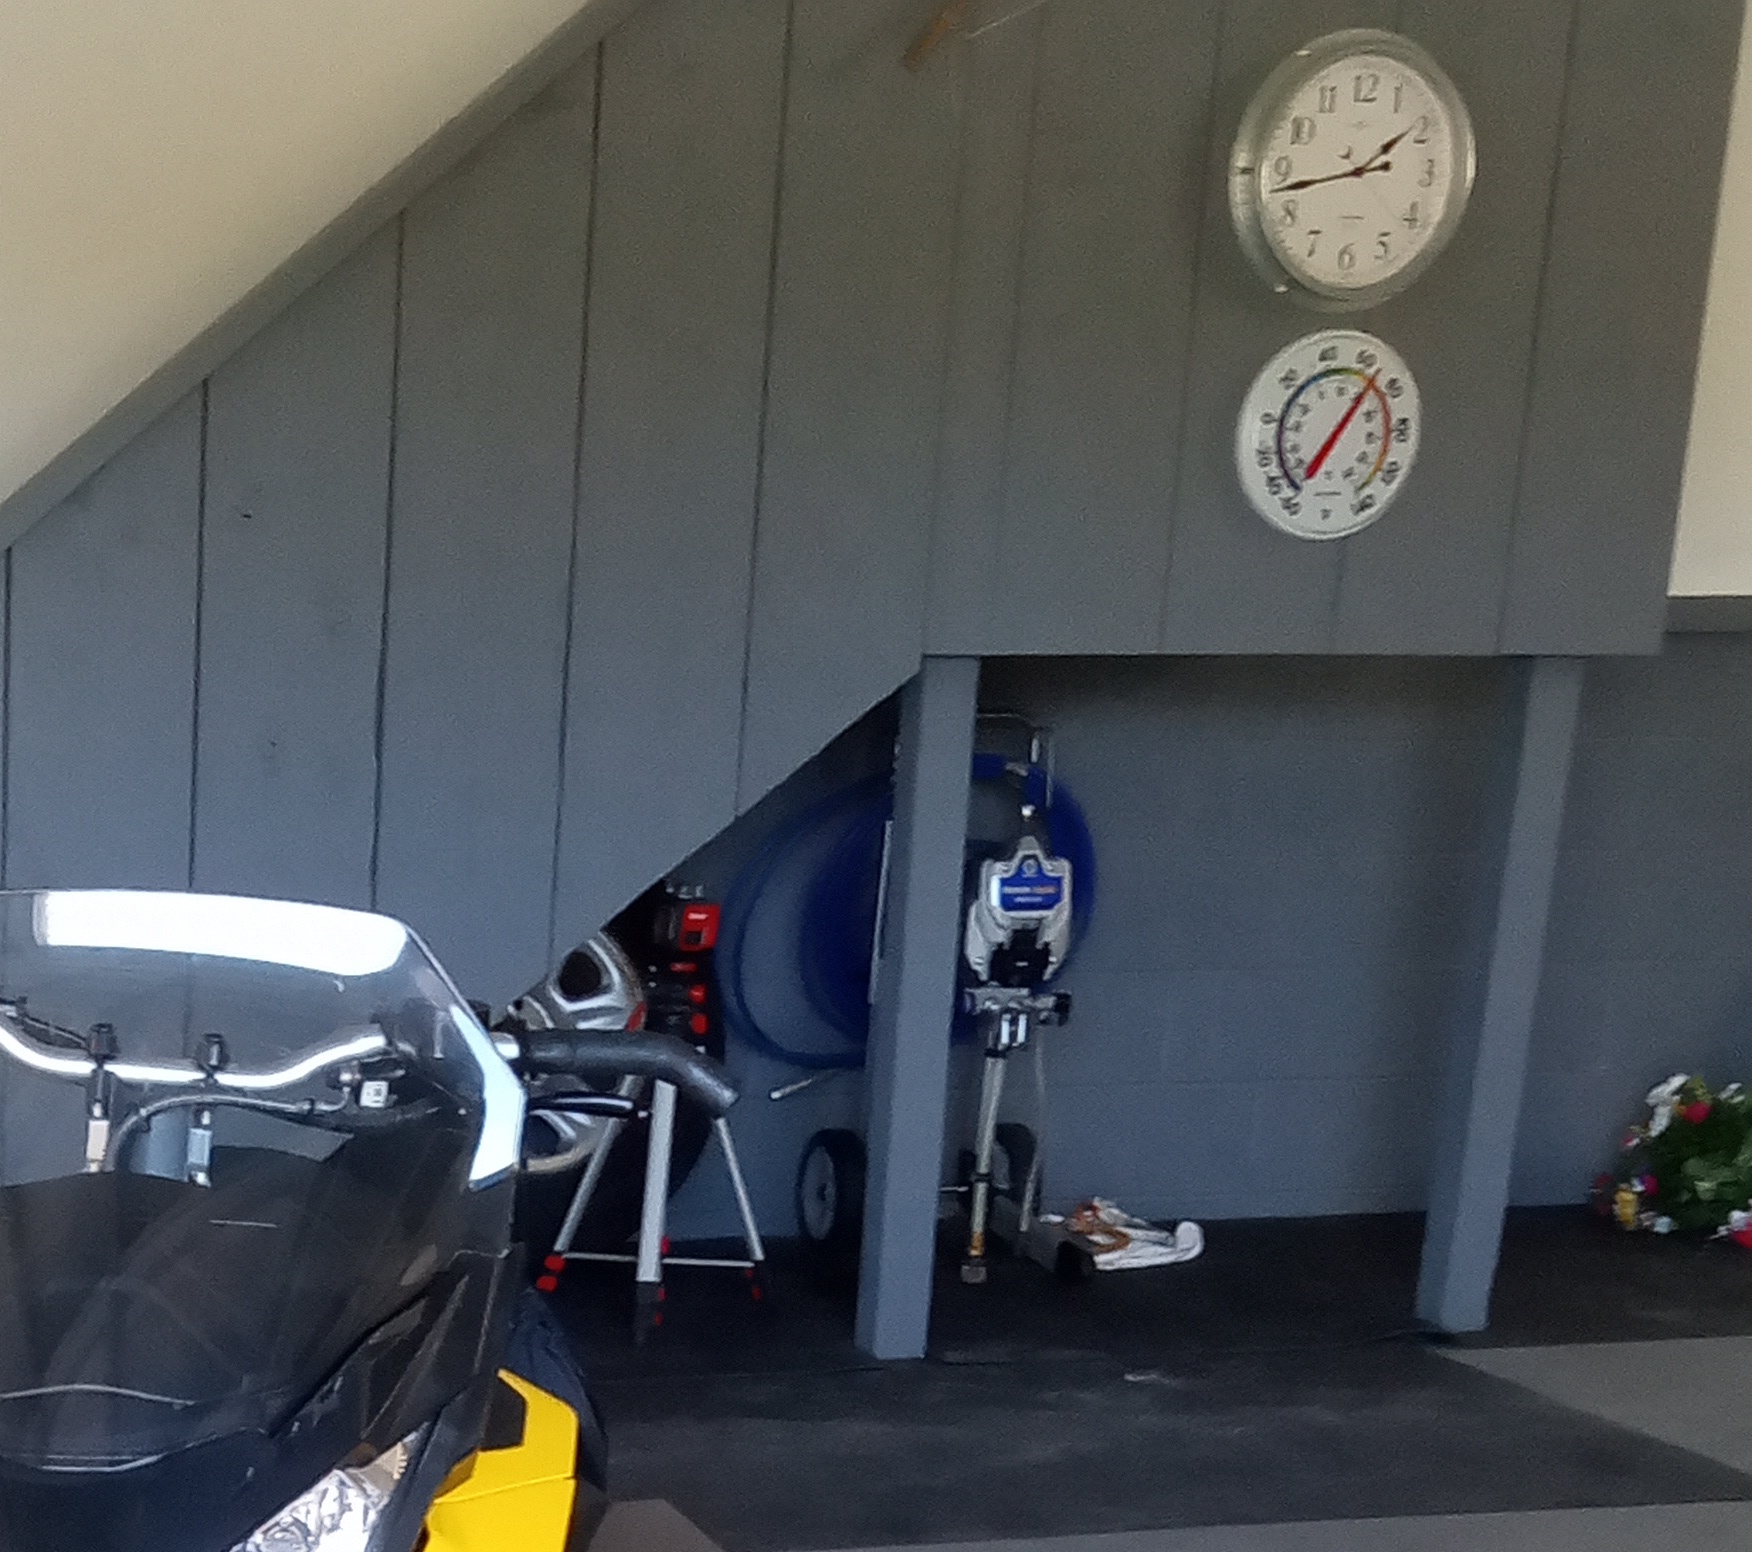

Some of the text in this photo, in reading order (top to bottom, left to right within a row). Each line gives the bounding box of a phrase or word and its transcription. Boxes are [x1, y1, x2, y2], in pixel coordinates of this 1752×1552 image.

[1318, 85, 1338, 114] 11
[1353, 74, 1380, 103] 12
[1393, 83, 1403, 114] 1
[1290, 116, 1317, 145] 10
[1413, 115, 1430, 145] 2
[1274, 155, 1292, 185] 9
[1417, 158, 1435, 187] 3
[1403, 201, 1419, 229] 4
[1307, 229, 1323, 258] 7
[1337, 243, 1356, 270] 6
[1374, 232, 1392, 260] 5
